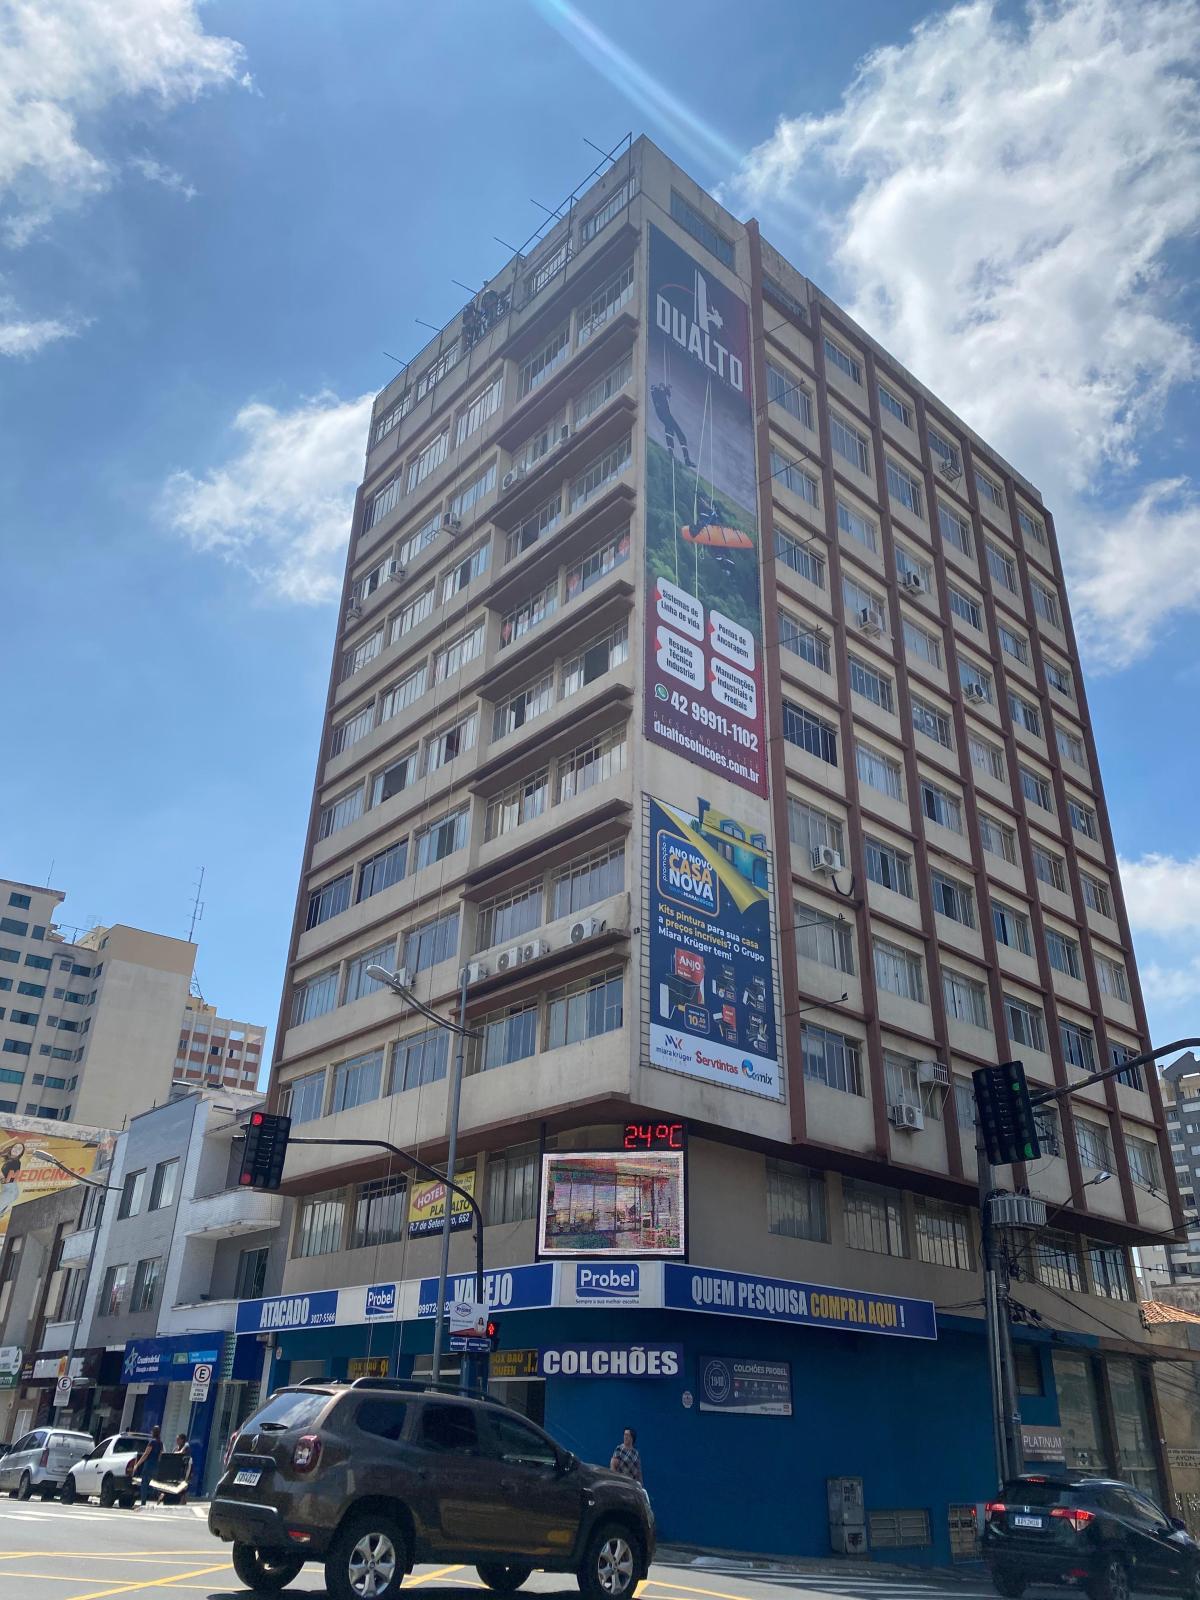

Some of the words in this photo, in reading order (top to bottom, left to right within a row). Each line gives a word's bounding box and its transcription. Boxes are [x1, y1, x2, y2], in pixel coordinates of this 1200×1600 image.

[656, 293, 743, 392] DUALTO
[661, 600, 678, 617] Linha
[678, 608, 687, 622] de
[687, 614, 700, 631] vida
[662, 588, 689, 614] Sistemas
[690, 605, 699, 618] de
[668, 637, 693, 659] Resgate
[716, 633, 749, 659] Ancoragem
[718, 623, 738, 642] Pontos
[738, 634, 747, 647] de
[666, 658, 696, 682] Industrial
[669, 648, 693, 669] Técnico
[715, 664, 755, 693] Manutenções
[717, 677, 749, 702] Industriais
[724, 692, 748, 712] Prediais
[670, 690, 689, 716] 42
[691, 701, 759, 754] 99911-1102
[654, 718, 760, 784] dualtosolucoes.com.br
[669, 845, 688, 862] ANO
[689, 852, 714, 872] NOVO
[669, 855, 713, 888] CASA
[669, 869, 714, 902] NOVA
[658, 903, 674, 918] Kits
[676, 911, 706, 930] pintura
[707, 921, 725, 937] para
[726, 930, 740, 942] sua
[741, 934, 759, 949] casa
[658, 925, 682, 942] Miara
[683, 936, 712, 956] Krüger
[713, 947, 732, 961] tem!
[665, 918, 693, 937] preços
[694, 926, 732, 949] incríveis?
[733, 943, 740, 953] O
[741, 946, 765, 962] Grupo
[656, 1046, 672, 1058] miara
[696, 1050, 738, 1075] Servtintas
[624, 1124, 683, 1149] 24°C
[417, 1186, 444, 1208] HOTEL
[429, 1199, 470, 1217] PLAALTO
[419, 1221, 427, 1230] de
[458, 1213, 470, 1224] 652
[581, 1269, 636, 1288] Probel
[368, 1289, 395, 1307] Probel
[691, 1275, 735, 1307] QUEM
[738, 1281, 808, 1316] PESQUISA
[810, 1292, 867, 1324] COMPRA
[868, 1301, 897, 1328] AQUI
[260, 1297, 310, 1329] ATACADO
[310, 1312, 336, 1325] 3027-5566
[543, 1346, 679, 1375] COLCHÕES
[1023, 1435, 1062, 1449] PLATINUM
